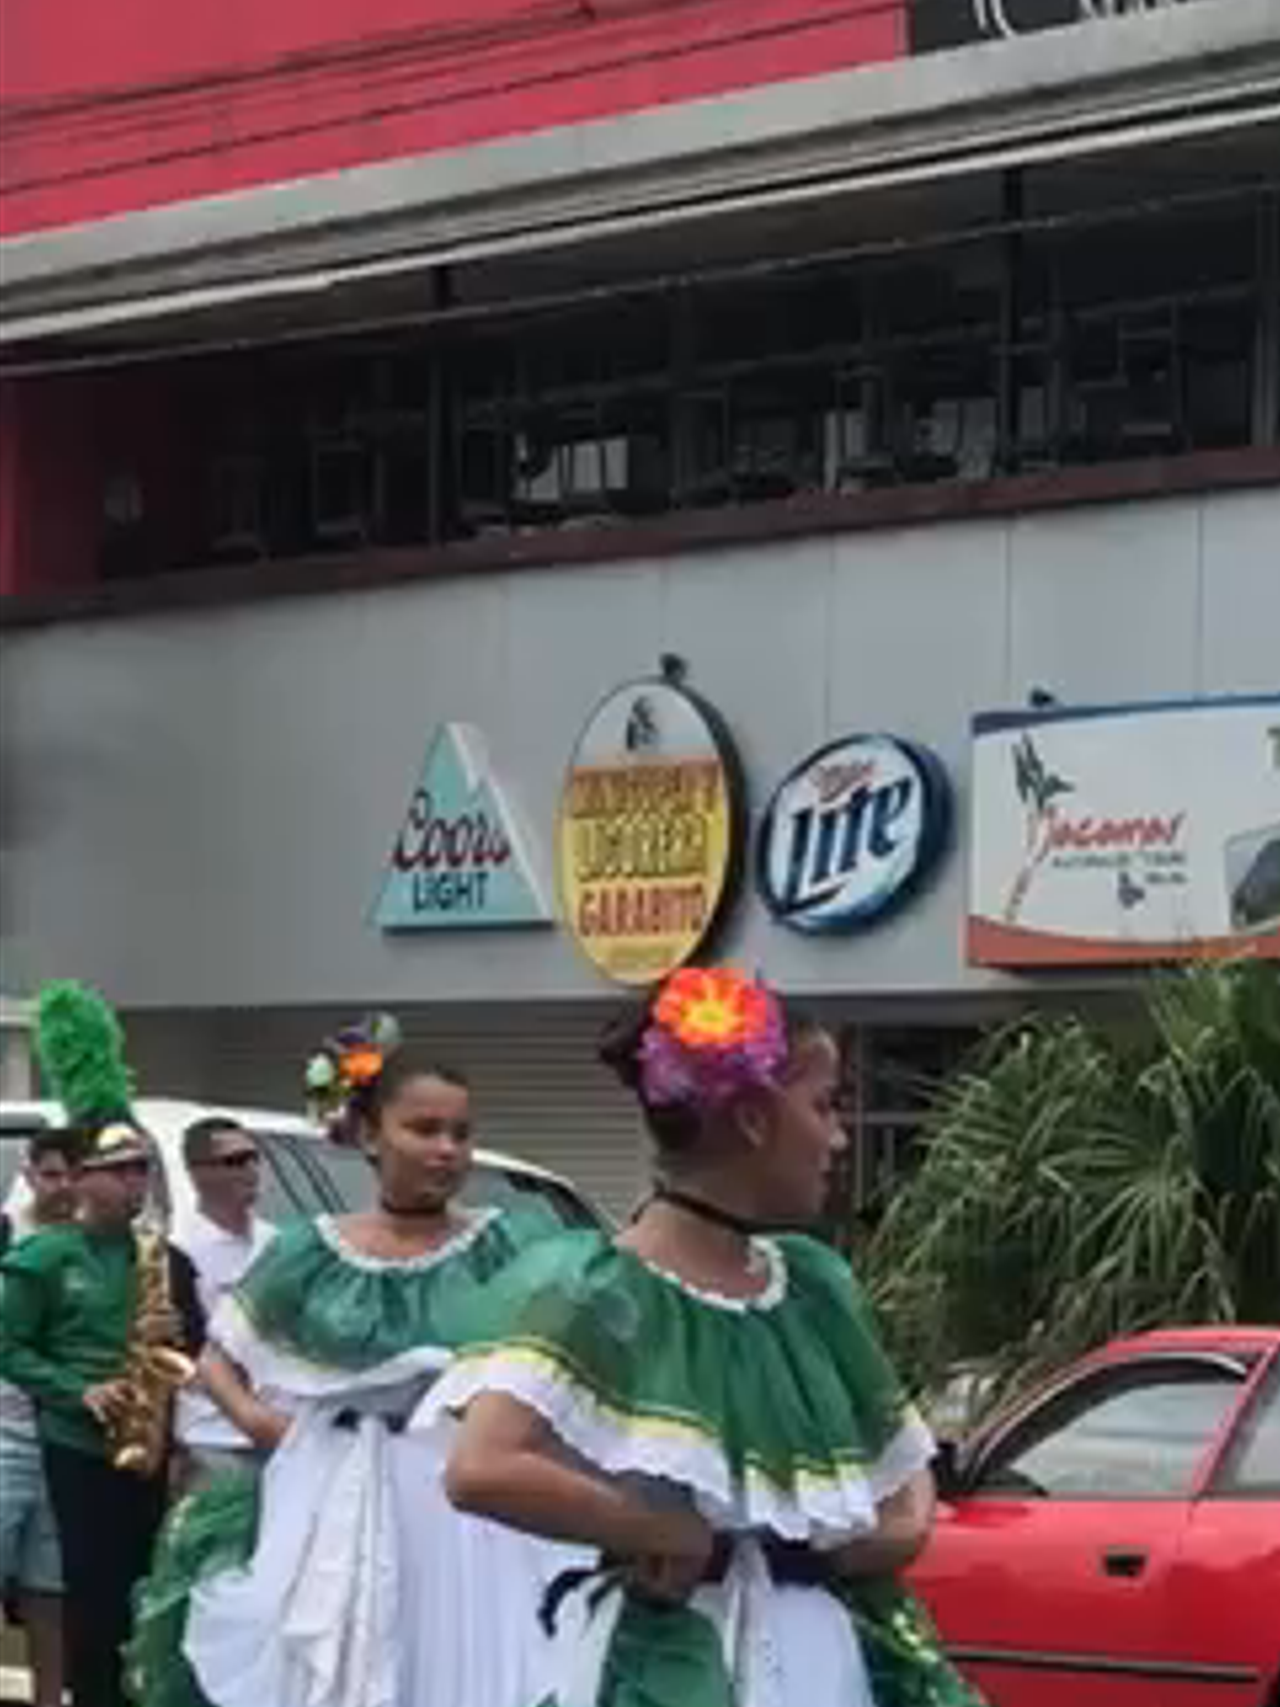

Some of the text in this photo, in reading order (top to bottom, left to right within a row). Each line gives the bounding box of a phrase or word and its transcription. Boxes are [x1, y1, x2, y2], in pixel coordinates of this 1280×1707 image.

[784, 775, 914, 915] Lite
[412, 871, 490, 915] LIGHT
[579, 883, 706, 937] GARABITO
